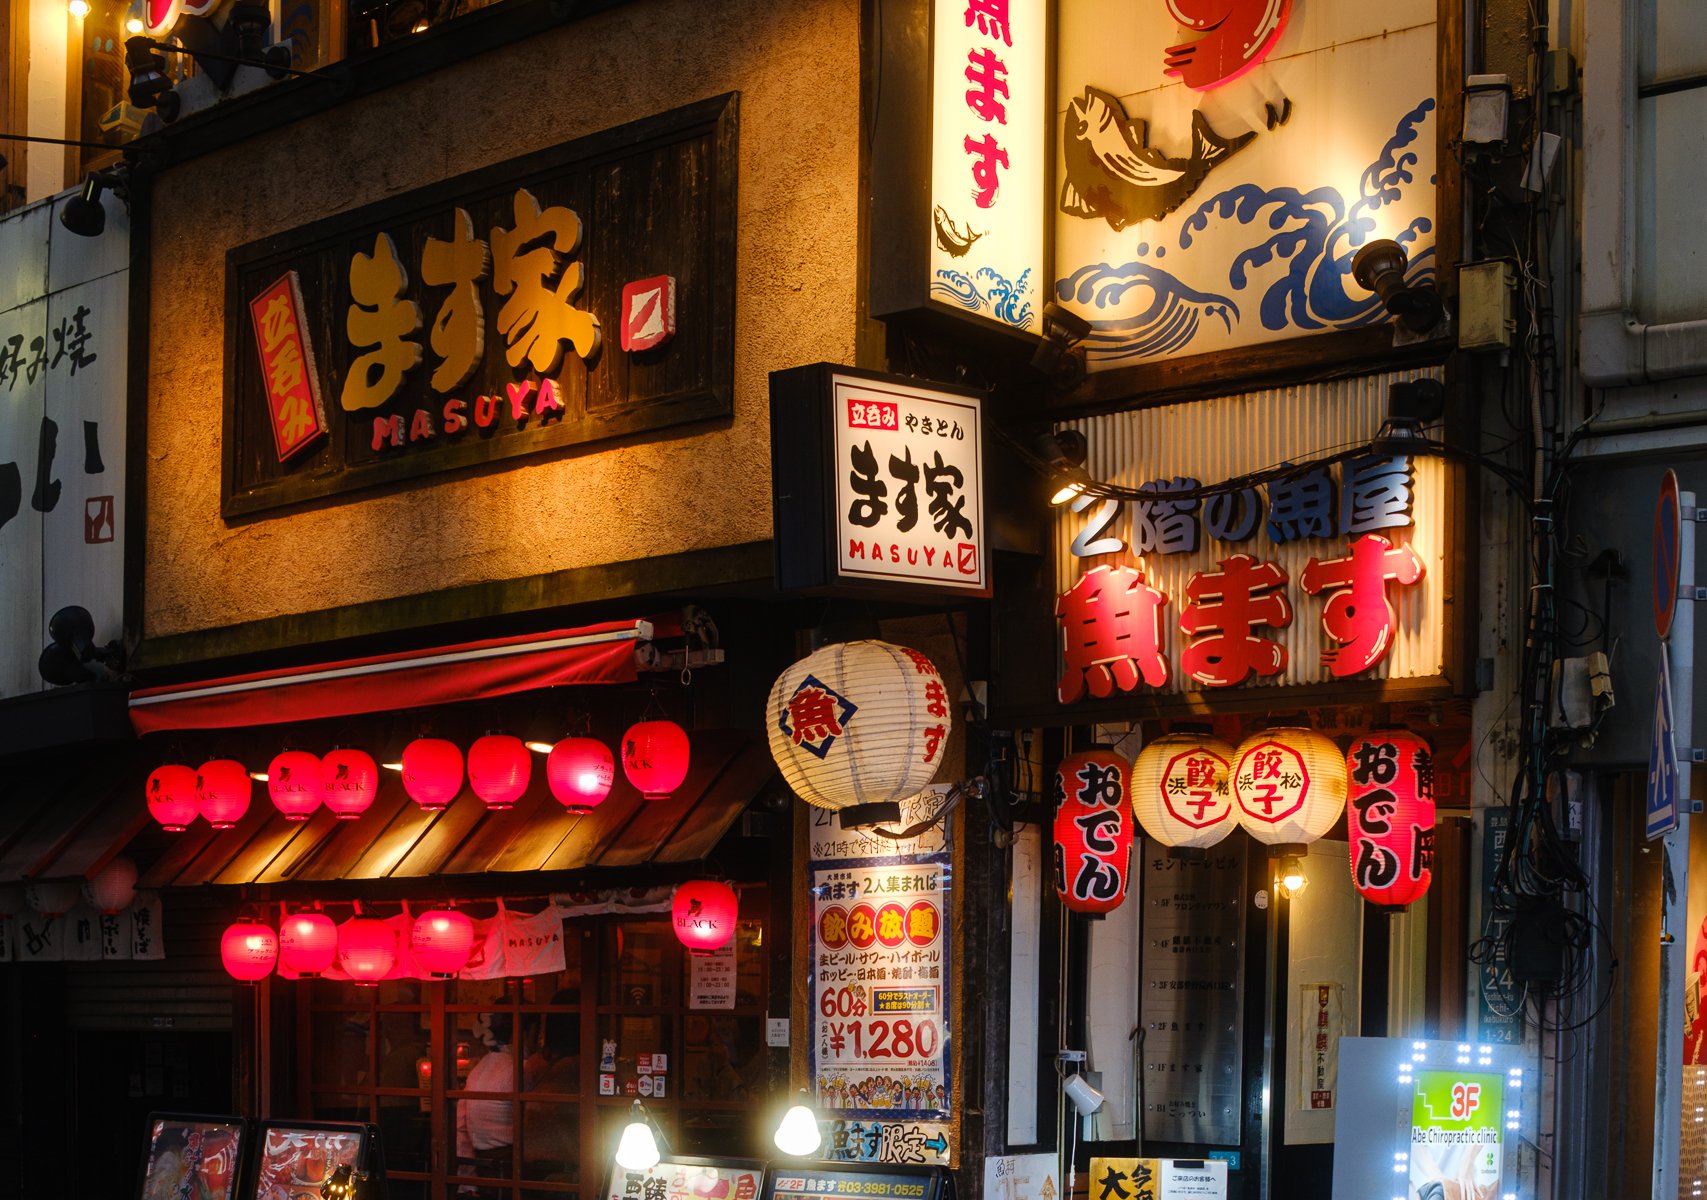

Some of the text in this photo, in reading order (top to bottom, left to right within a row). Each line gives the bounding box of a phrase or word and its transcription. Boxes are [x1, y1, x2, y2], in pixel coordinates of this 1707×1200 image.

[341, 188, 600, 412] ます家
[371, 378, 565, 451] MASUYA
[905, 413, 965, 441] やきとん
[848, 440, 973, 540] ます家
[1071, 455, 1414, 558] 2階の魚屋
[849, 538, 954, 569] MASUYA
[1055, 534, 1427, 704] 魚ます
[325, 781, 365, 793] BLACK
[1186, 757, 1217, 820] 餃子
[1253, 750, 1284, 815] 餃子
[1074, 762, 1123, 901] おでん
[1352, 742, 1398, 890] おでん
[508, 934, 560, 948] MASUYA
[676, 917, 718, 929] BLACK
[822, 905, 936, 943] 飲み放題
[1485, 966, 1514, 990] 24
[829, 1019, 939, 1060] ¥1,280
[1158, 1022, 1167, 1031] 2F
[1486, 1030, 1512, 1042] 1-24
[1452, 1084, 1480, 1121] 3F
[1411, 1127, 1498, 1147] Abe Chiropractic clinic
[806, 1180, 838, 1192] 魚ます
[845, 1181, 925, 1197] 03-3981-0525
